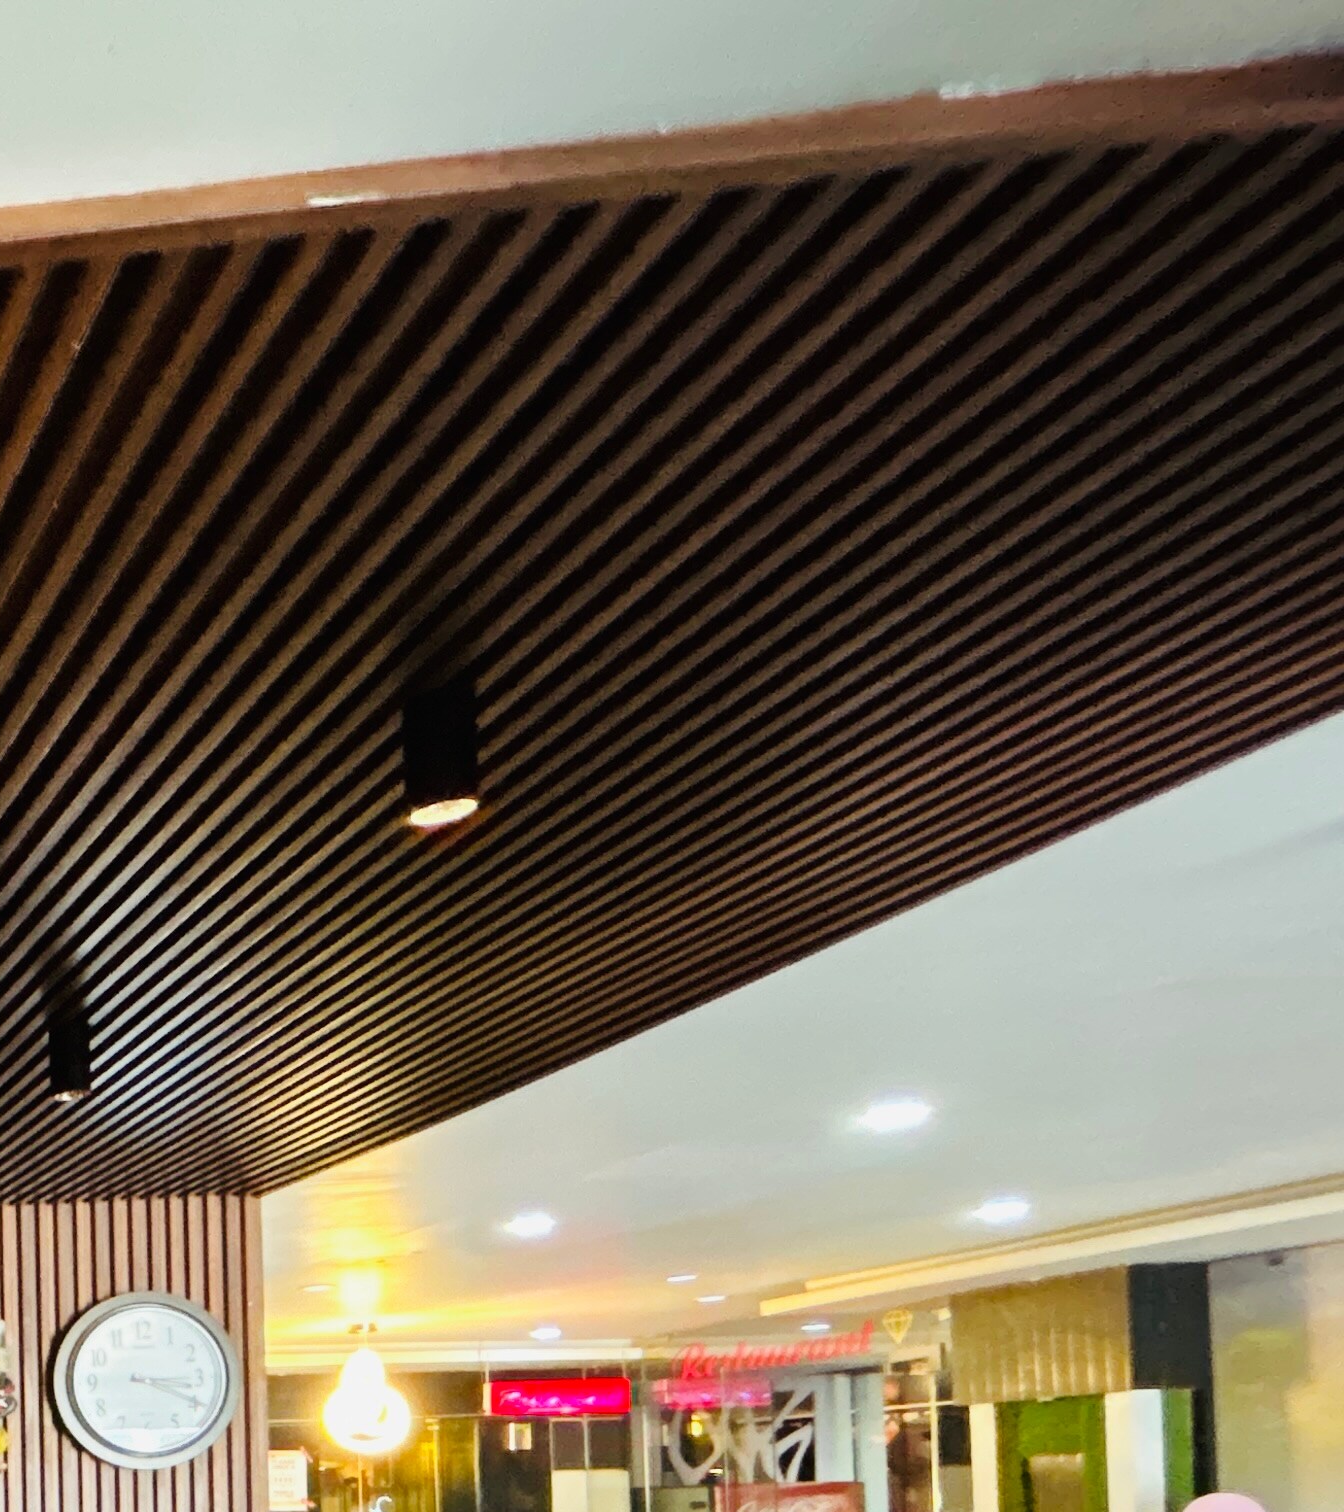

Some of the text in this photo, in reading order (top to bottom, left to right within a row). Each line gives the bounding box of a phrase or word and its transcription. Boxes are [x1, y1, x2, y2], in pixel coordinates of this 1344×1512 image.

[111, 1328, 124, 1348] 11
[134, 1320, 152, 1341] 12
[167, 1325, 175, 1346] 1
[90, 1348, 107, 1368] 10
[185, 1342, 197, 1363] 2
[86, 1373, 98, 1393] 9
[195, 1367, 205, 1387] 3
[95, 1398, 107, 1417] 8
